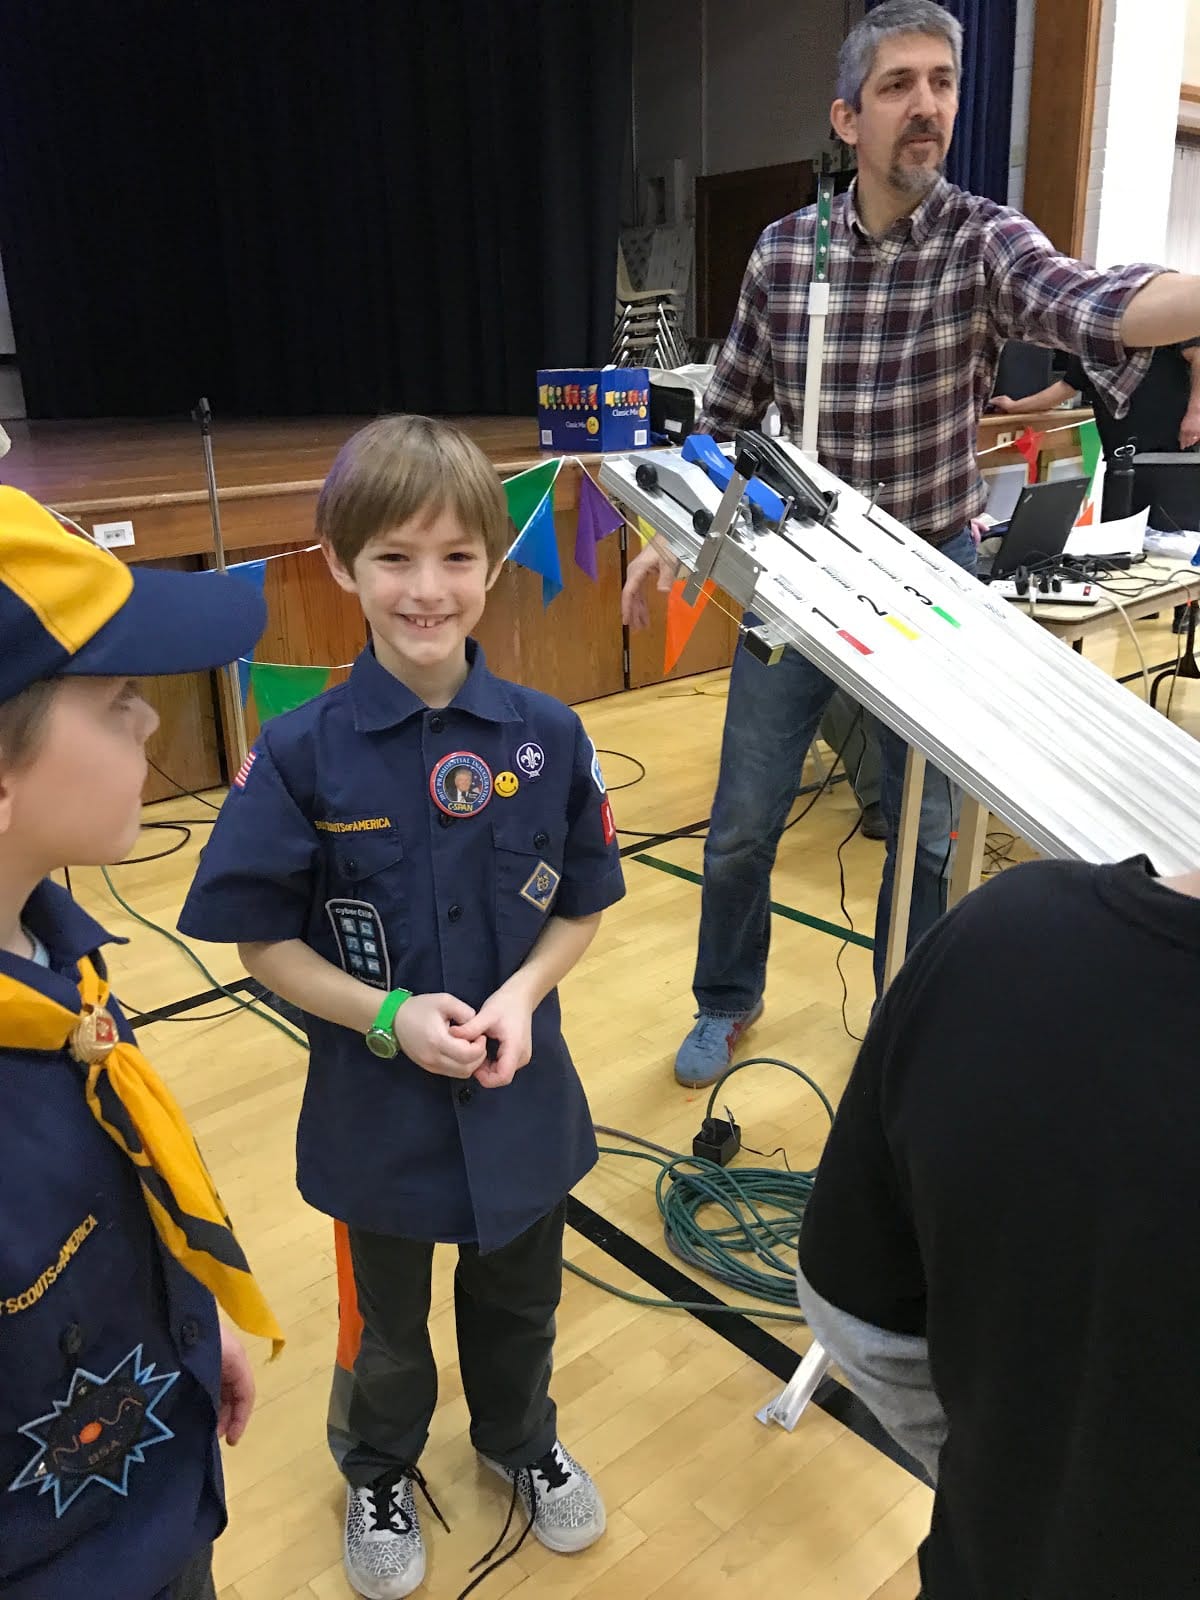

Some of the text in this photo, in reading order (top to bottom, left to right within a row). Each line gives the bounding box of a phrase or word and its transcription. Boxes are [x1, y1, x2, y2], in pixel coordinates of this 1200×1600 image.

[857, 594, 888, 617] 2
[903, 585, 933, 606] 3
[812, 606, 839, 629] 1
[436, 757, 470, 787] PRESIDENTIAL
[447, 802, 473, 812] C-SPAN
[353, 817, 391, 832] AMERICA
[5, 1266, 58, 1314] SCOUTS
[59, 1213, 99, 1262] AMERICA
